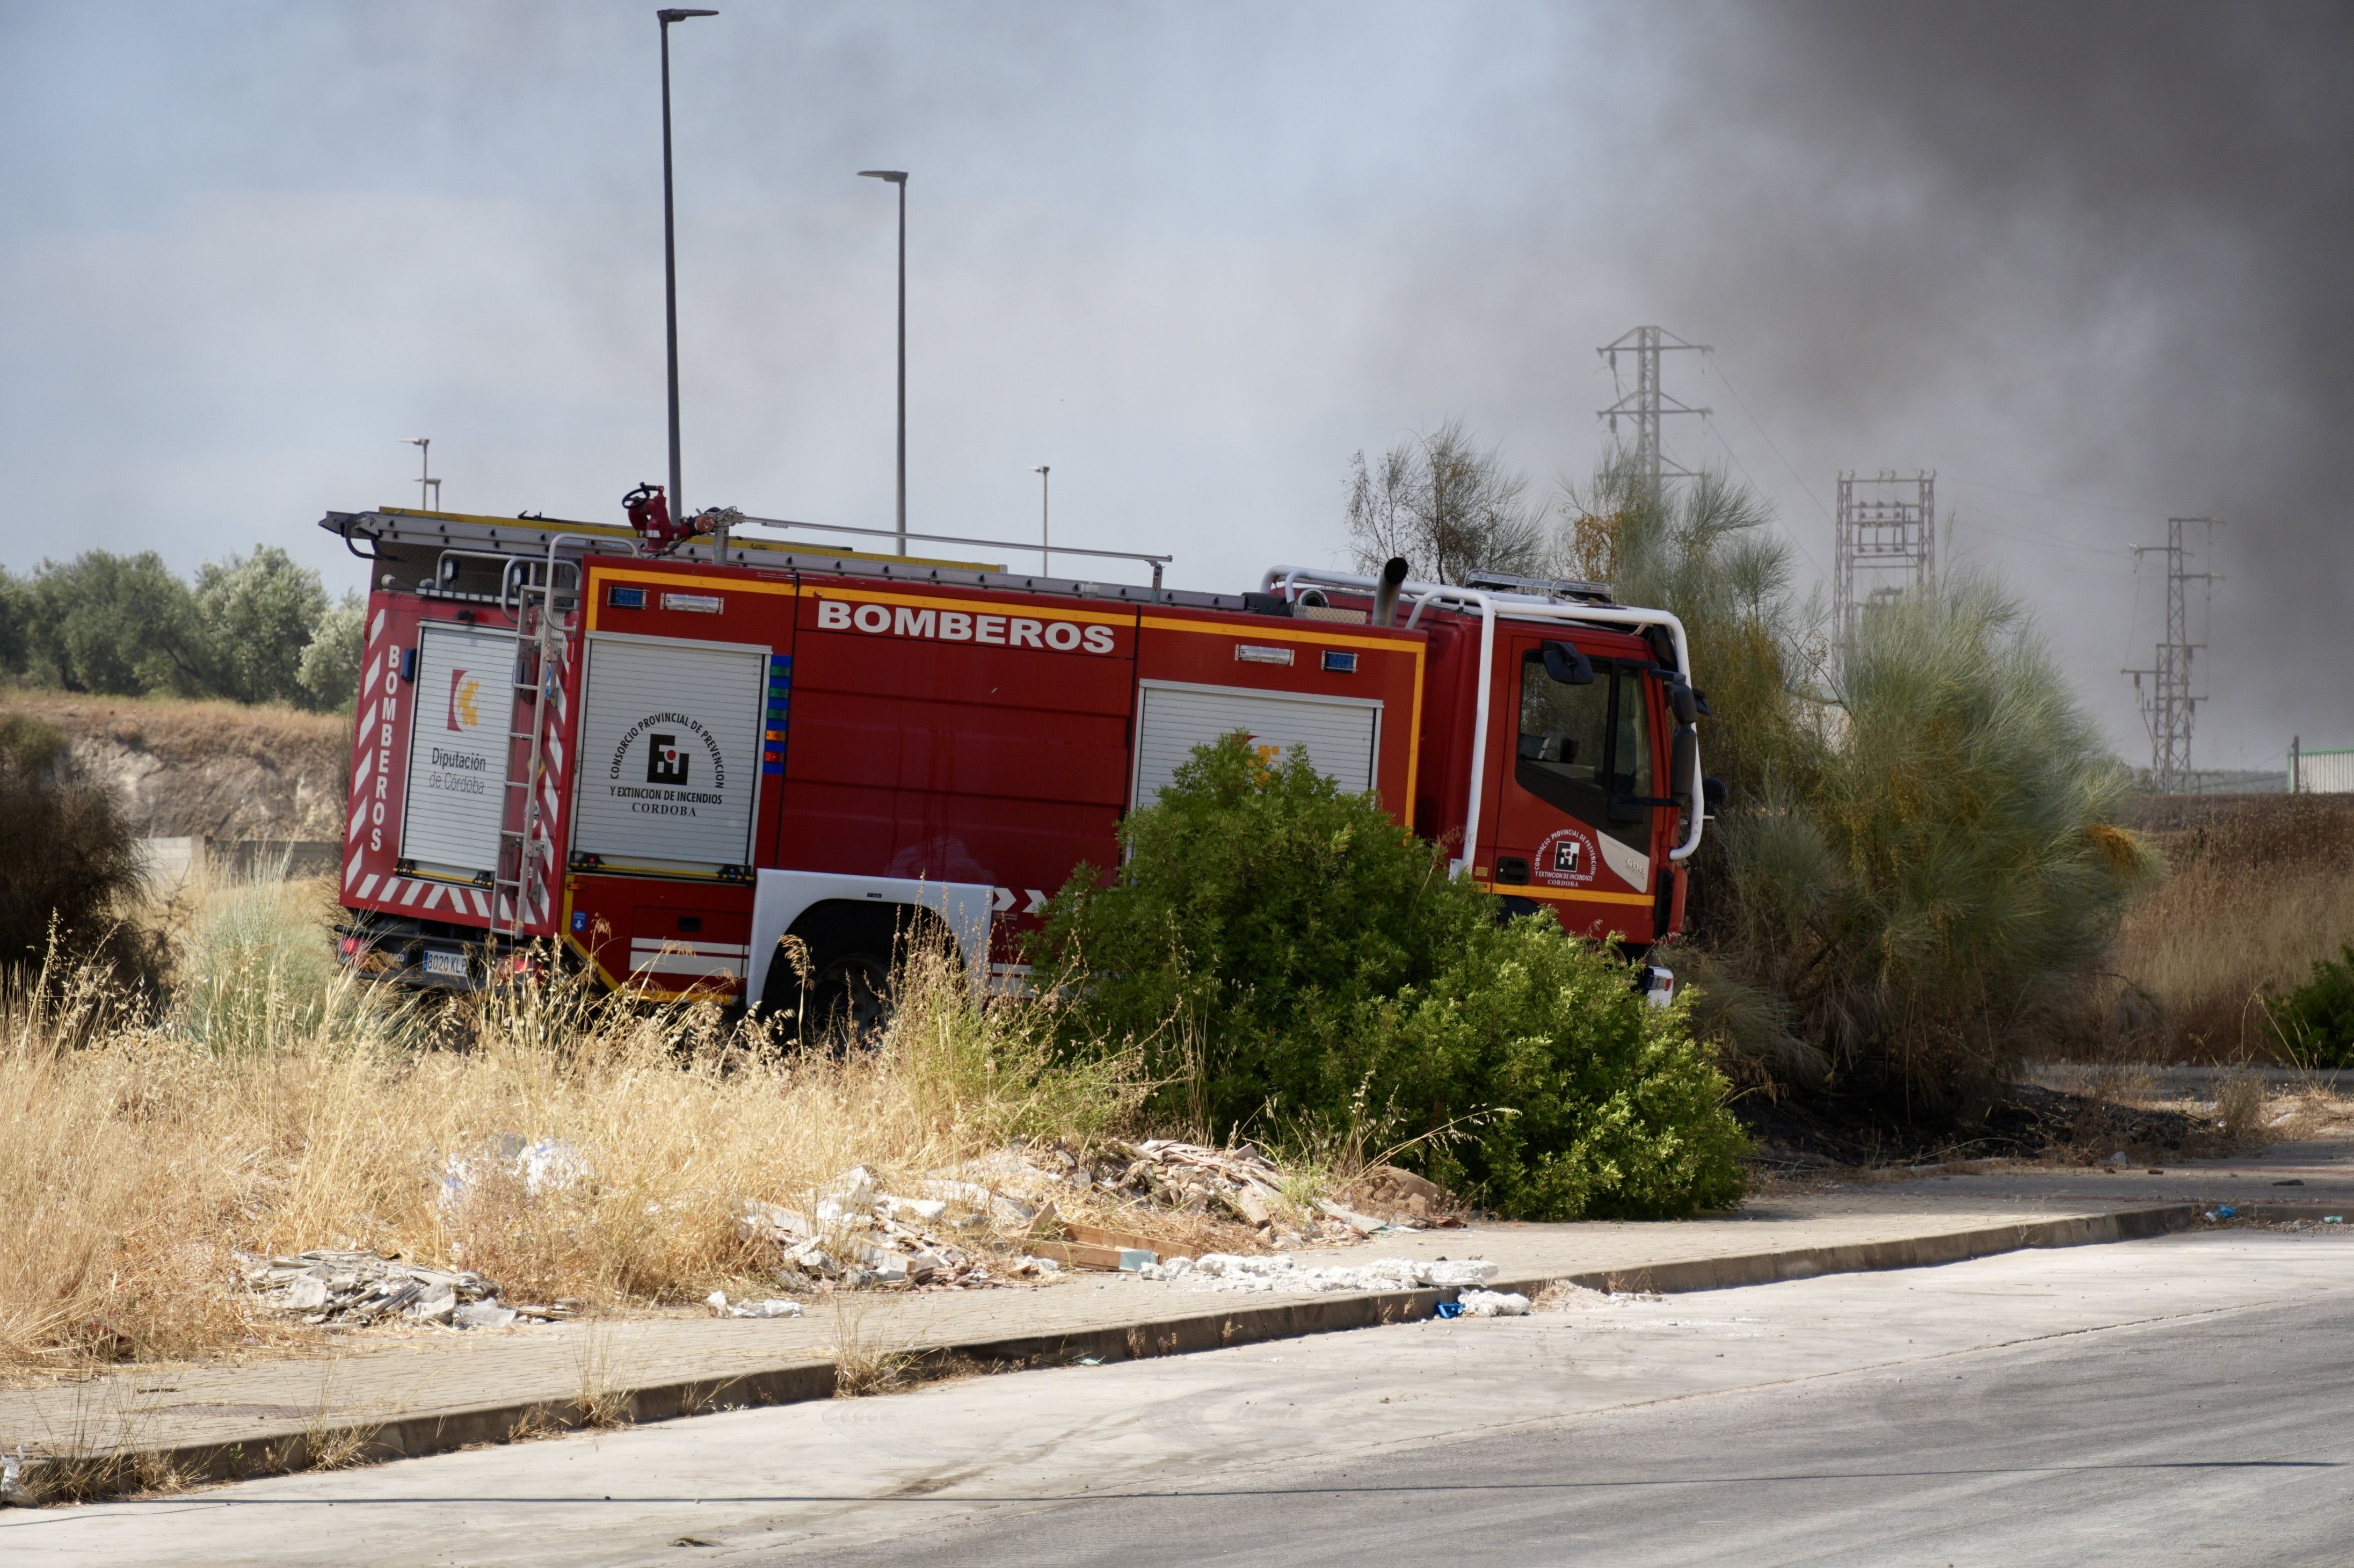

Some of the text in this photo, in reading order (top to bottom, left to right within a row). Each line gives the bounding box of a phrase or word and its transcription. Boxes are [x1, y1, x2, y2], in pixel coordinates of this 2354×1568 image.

[818, 601, 1114, 654] BOMBEROS
[371, 645, 399, 852] BOMBEROS
[432, 747, 485, 771] Diputación
[611, 713, 724, 788] CONSORCIO PROVINCIAL DE PREVENCION
[430, 771, 484, 794] de Córdoba
[610, 786, 722, 804] Y EXTINCION DE INCENDIOS
[632, 802, 696, 816] CORDOBA
[1535, 829, 1596, 875] CONSORCIO PROVINCIAL DE PREVENCION
[1538, 871, 1563, 879] EXTINCION
[1570, 874, 1593, 882] INCENDIOS
[1547, 879, 1579, 887] CORDOBA
[428, 954, 449, 971] 8020
